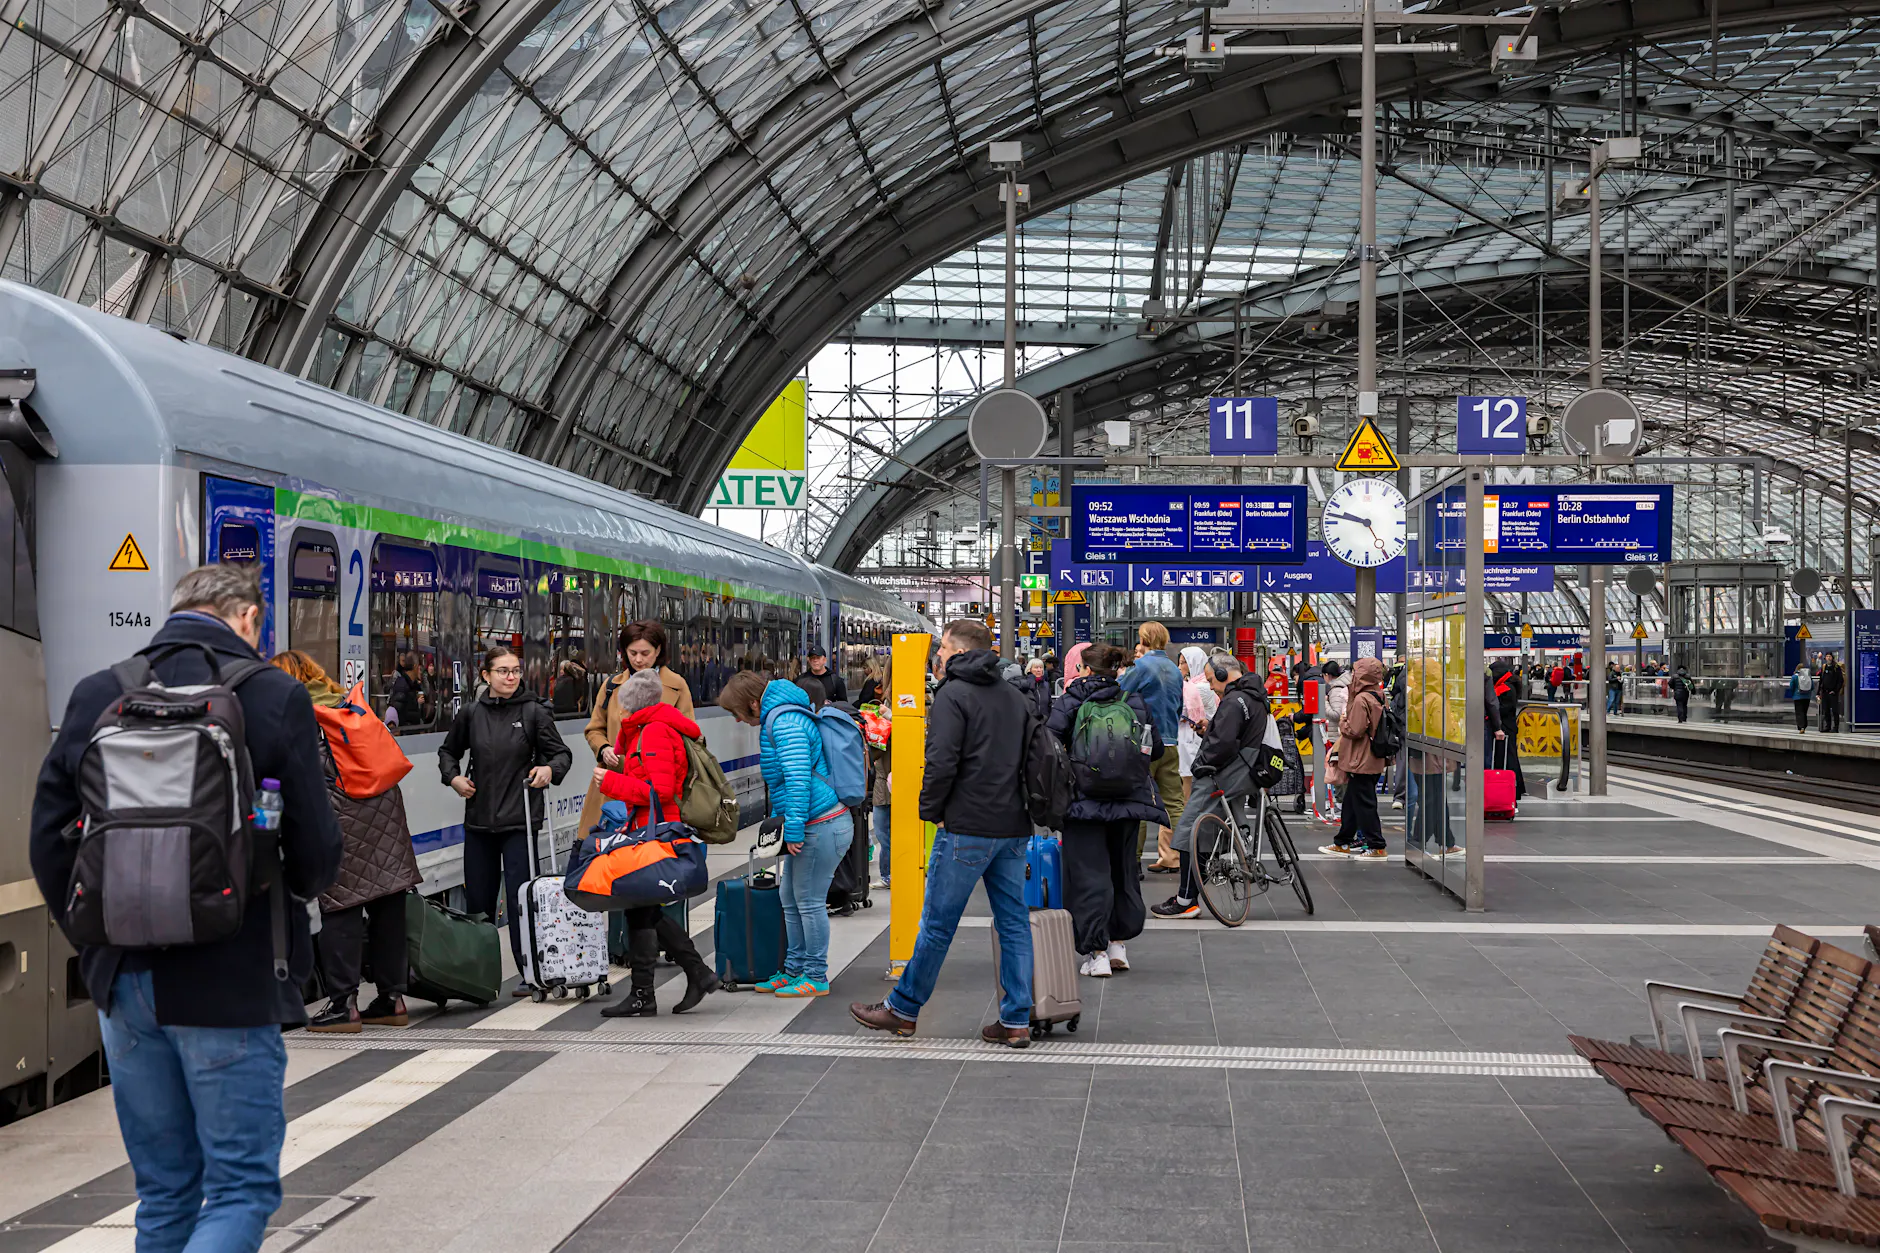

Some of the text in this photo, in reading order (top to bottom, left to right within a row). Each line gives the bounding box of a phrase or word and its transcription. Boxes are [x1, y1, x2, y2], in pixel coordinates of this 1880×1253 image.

[1216, 400, 1252, 439] 11
[1472, 398, 1519, 438] 12
[1088, 502, 1113, 511] 09:52
[1558, 502, 1582, 511] 10:28
[1088, 514, 1170, 524] Warszawa Wschodnia
[1558, 514, 1630, 524] Berlin Ostbahnhof
[1085, 552, 1117, 560] Gleis 11
[1625, 553, 1658, 561] Gleis 12
[1029, 551, 1043, 574] F
[871, 576, 919, 587] Wachstum,
[1284, 572, 1312, 580] Ausgang
[348, 548, 364, 636] 2
[109, 612, 151, 626] 154Aa
[1508, 612, 1515, 623] E
[557, 798, 568, 818] PKP
